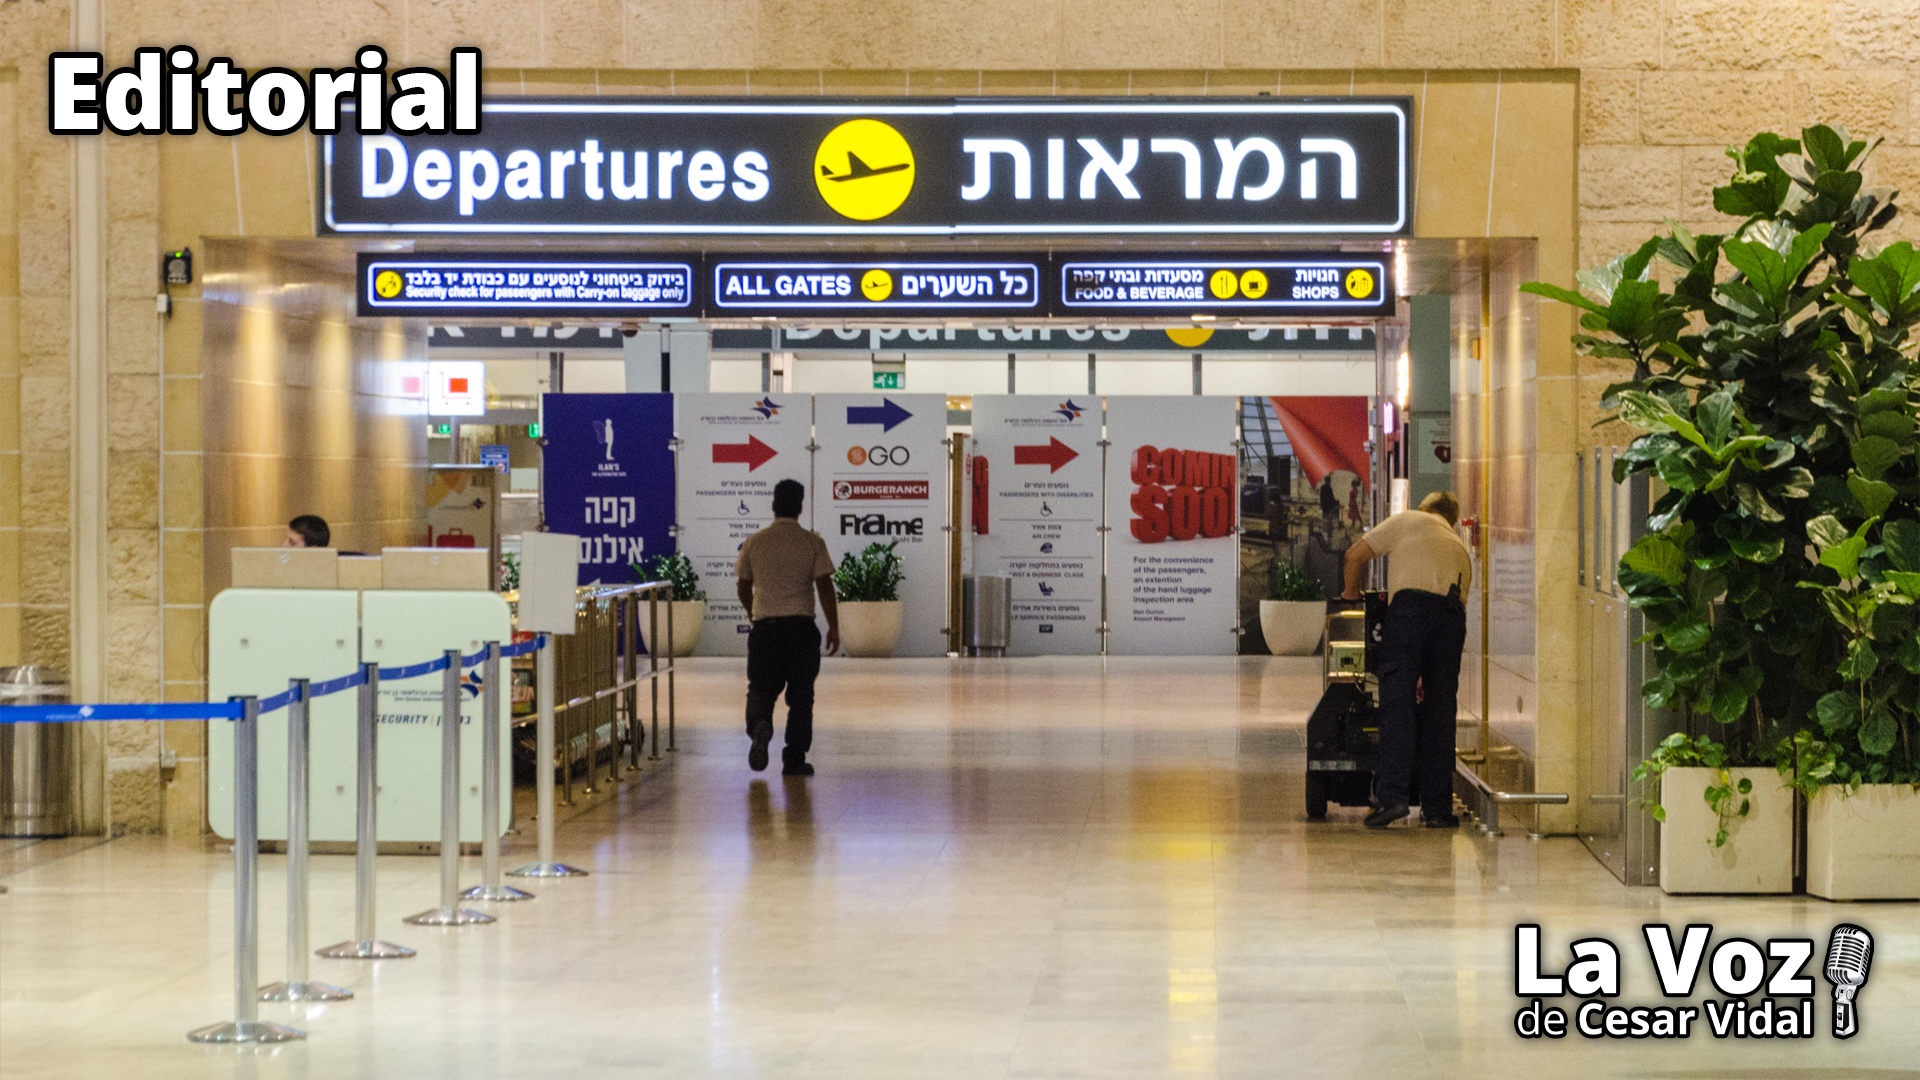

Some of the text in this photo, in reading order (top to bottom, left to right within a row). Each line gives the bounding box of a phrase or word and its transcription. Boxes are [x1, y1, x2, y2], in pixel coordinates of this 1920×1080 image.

[361, 135, 770, 215] Departures
[961, 137, 1358, 200] המראות
[404, 269, 685, 288] בידוק ביטחוני לנוסעים עם כבודת יד בלבד
[1072, 269, 1205, 285] מסעדות ובתי קפה
[1295, 269, 1340, 283] חנויות
[725, 275, 852, 296] ALL GATES
[902, 270, 1029, 299] כל השערים
[405, 285, 685, 301] Security check for passengers with Carry-on baggage only
[1075, 286, 1205, 300] FOOD & BEVERAGE
[1292, 286, 1340, 300] SHOPS
[868, 445, 910, 467] GO
[853, 485, 928, 495] BURGERANCH
[585, 496, 636, 528] קפה
[840, 513, 924, 536] Frame
[578, 533, 644, 564] אילנס
[1133, 556, 1214, 564] For the convenience
[1158, 567, 1206, 575] passengers,
[1180, 586, 1212, 595] luggage
[1133, 596, 1175, 604] inspection
